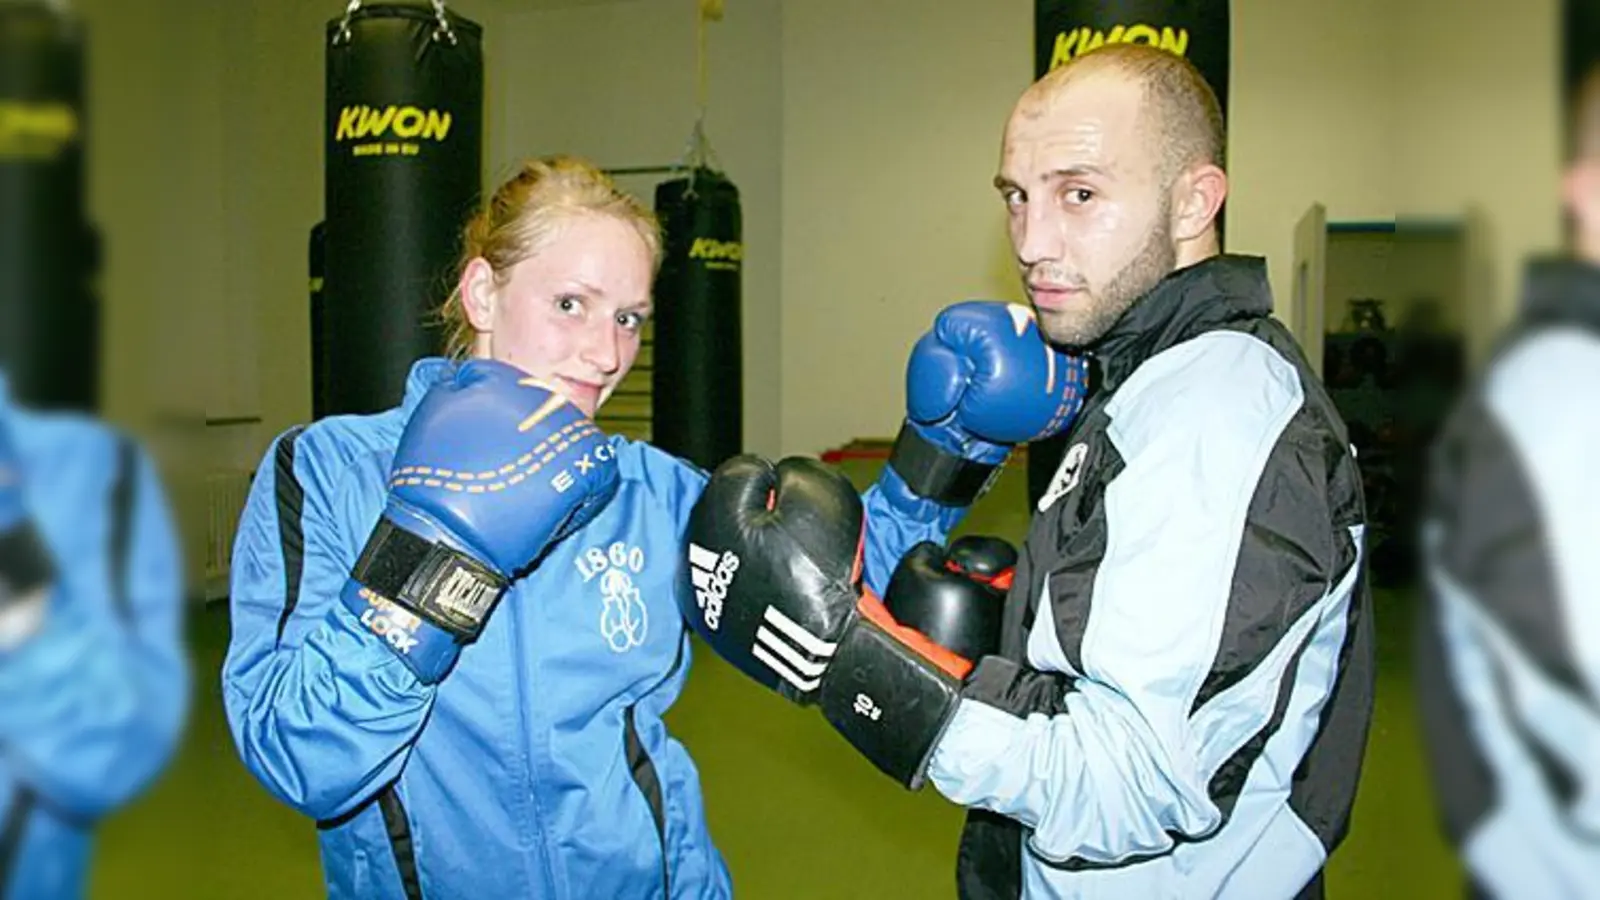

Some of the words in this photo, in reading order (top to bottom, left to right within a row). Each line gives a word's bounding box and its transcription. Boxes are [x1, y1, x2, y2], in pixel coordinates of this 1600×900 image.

[1050, 24, 1189, 70] KWON
[335, 104, 453, 141] KWON
[688, 238, 742, 260] KWO
[574, 541, 644, 583] 1860
[704, 550, 740, 631] adidas
[360, 608, 420, 654] LOCK
